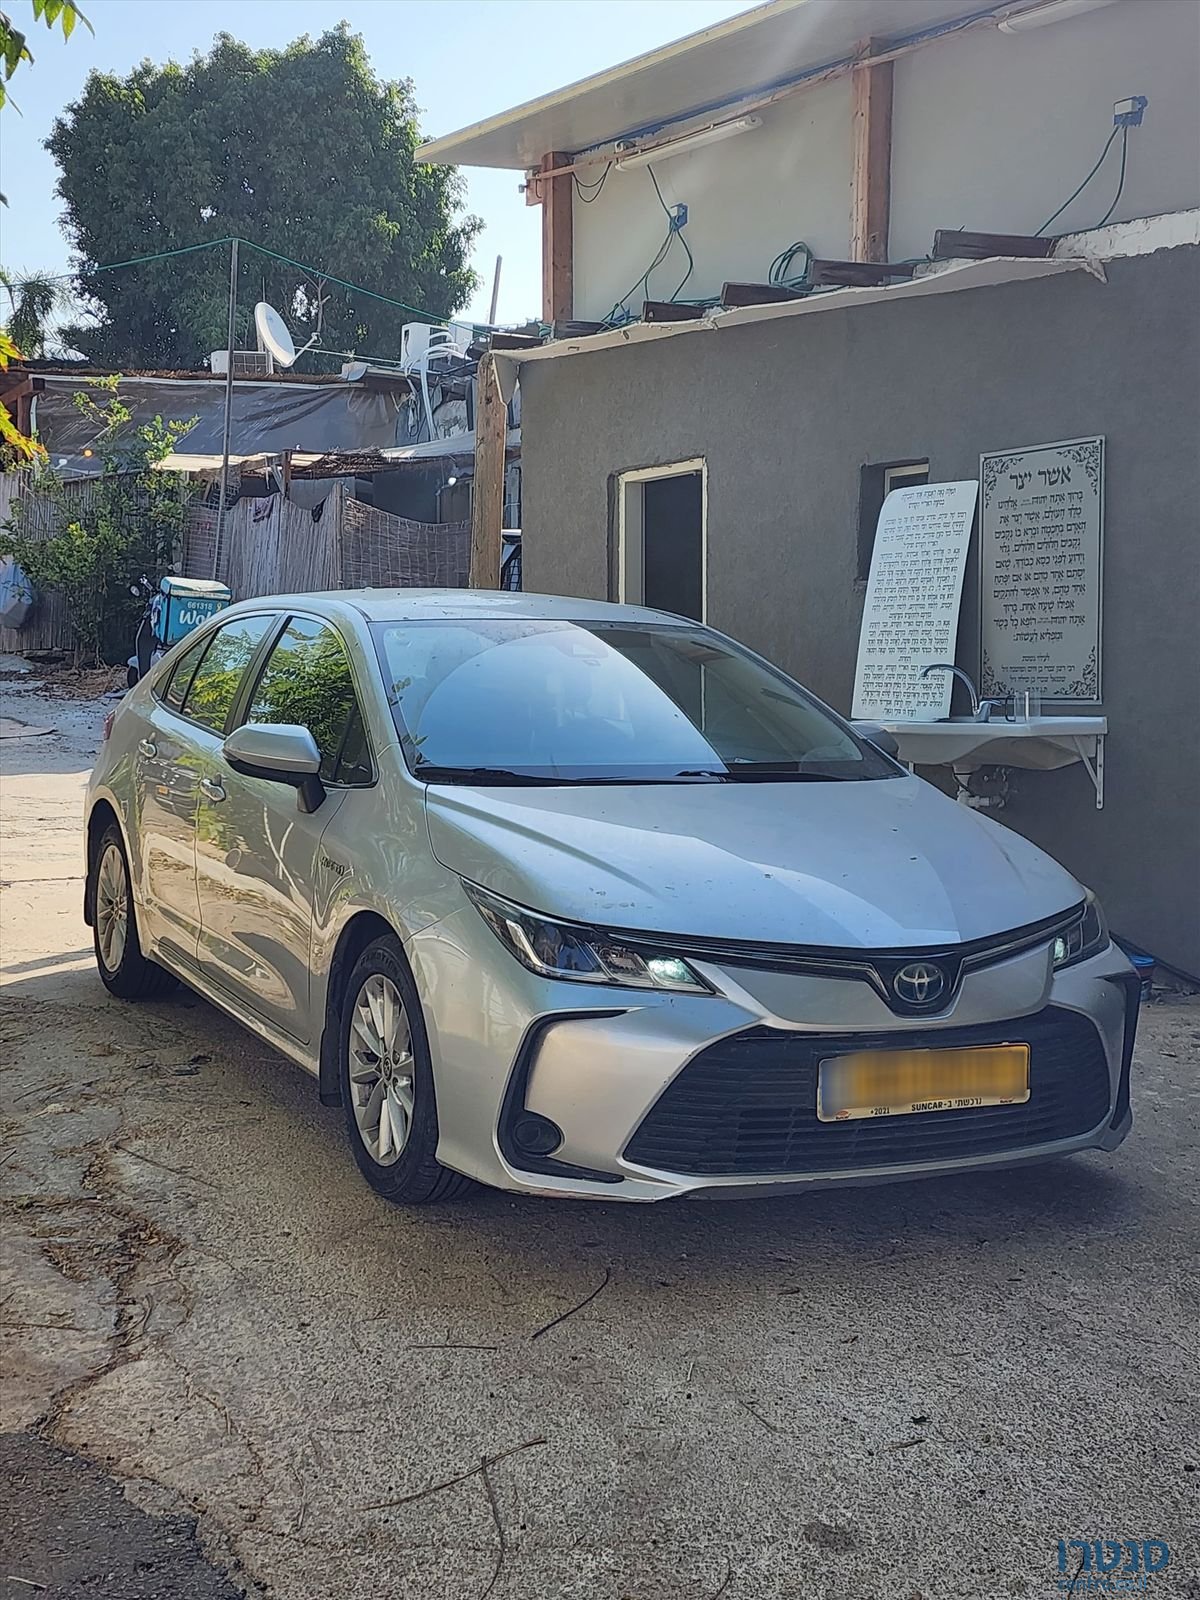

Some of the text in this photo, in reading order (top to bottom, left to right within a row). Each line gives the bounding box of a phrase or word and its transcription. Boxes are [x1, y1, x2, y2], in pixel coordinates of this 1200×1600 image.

[1010, 465, 1071, 490] אשר יצר
[187, 601, 213, 610] 661318
[179, 609, 212, 625] Wo
